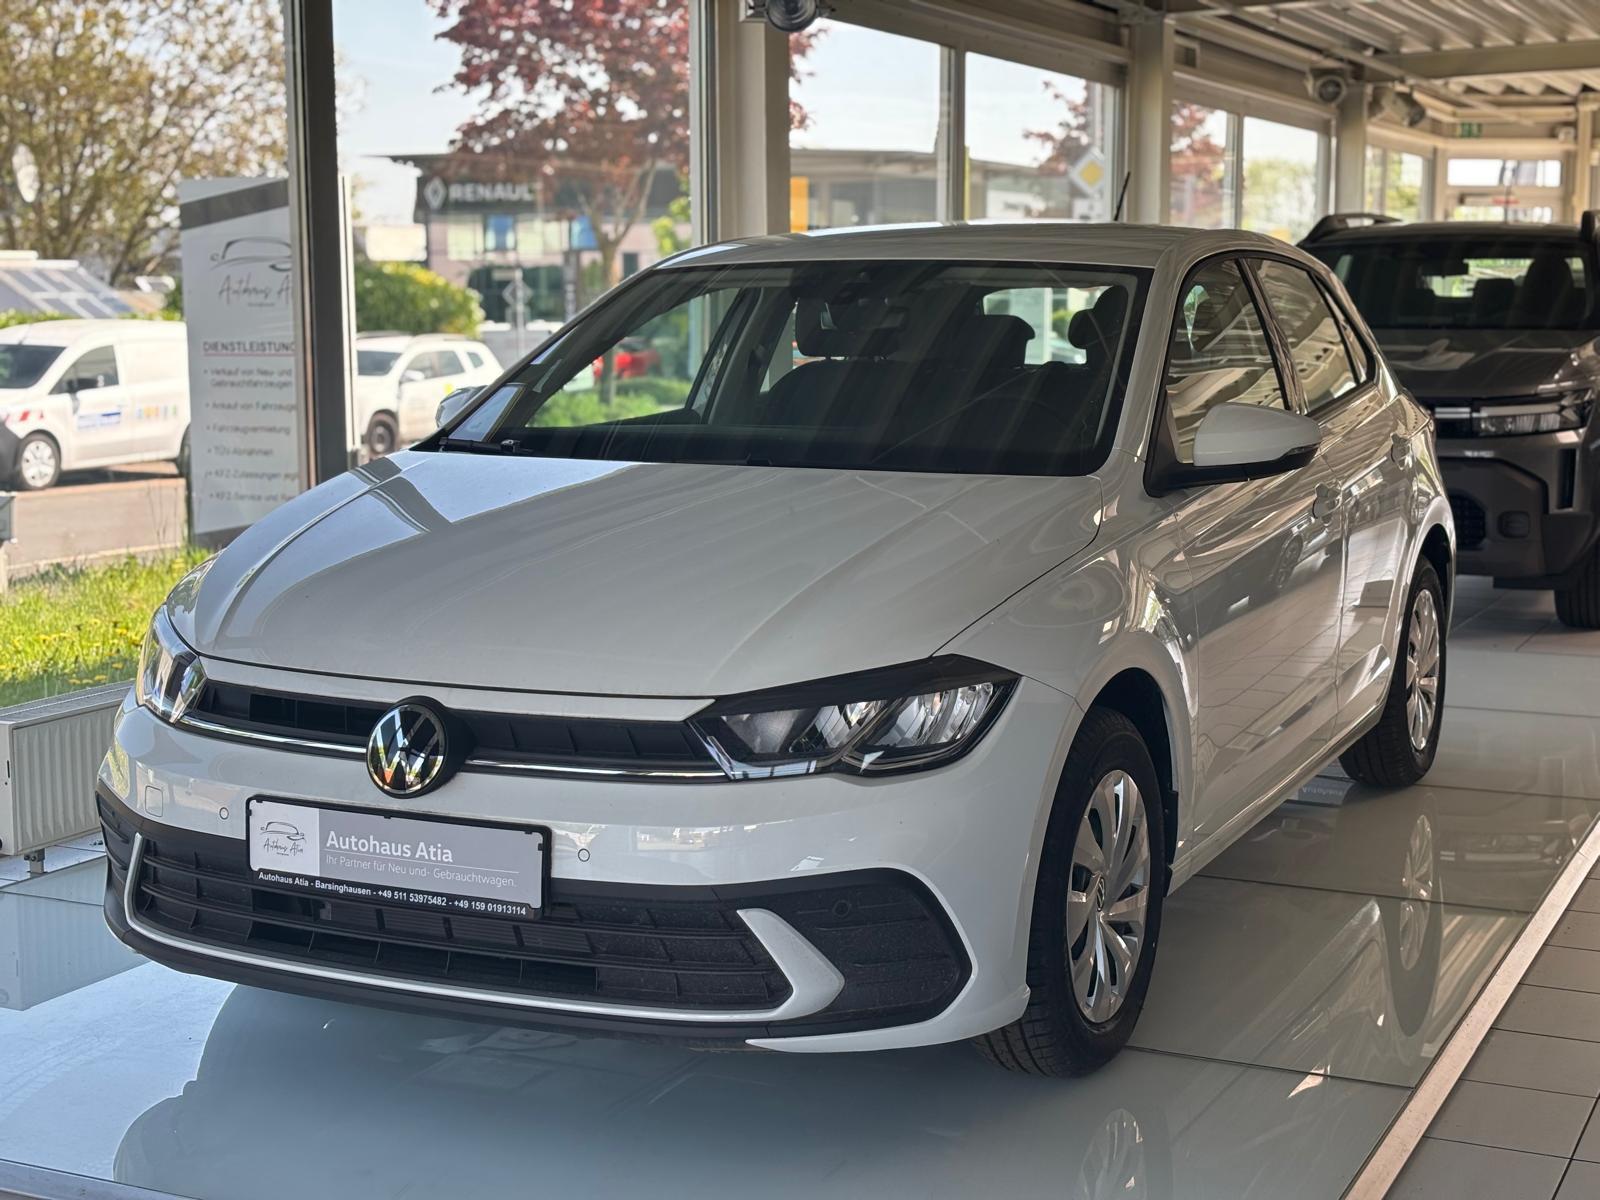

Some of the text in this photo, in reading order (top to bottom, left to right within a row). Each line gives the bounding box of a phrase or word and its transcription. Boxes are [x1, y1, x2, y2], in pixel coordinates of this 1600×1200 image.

[326, 830, 454, 863] Autohaus Atia
[326, 854, 338, 865] Ihr
[340, 856, 371, 870] Partner
[373, 860, 386, 872] für
[388, 863, 407, 874] Neu
[409, 867, 430, 877] und-
[258, 871, 293, 884] Autohaus
[294, 877, 309, 887] Atia
[315, 879, 372, 895] Barsinghausen
[378, 889, 392, 899] +49
[393, 891, 407, 901] 511
[409, 893, 447, 906] 53975482
[454, 899, 469, 909] +49
[471, 900, 486, 911] 159
[487, 902, 526, 915] 01913114
